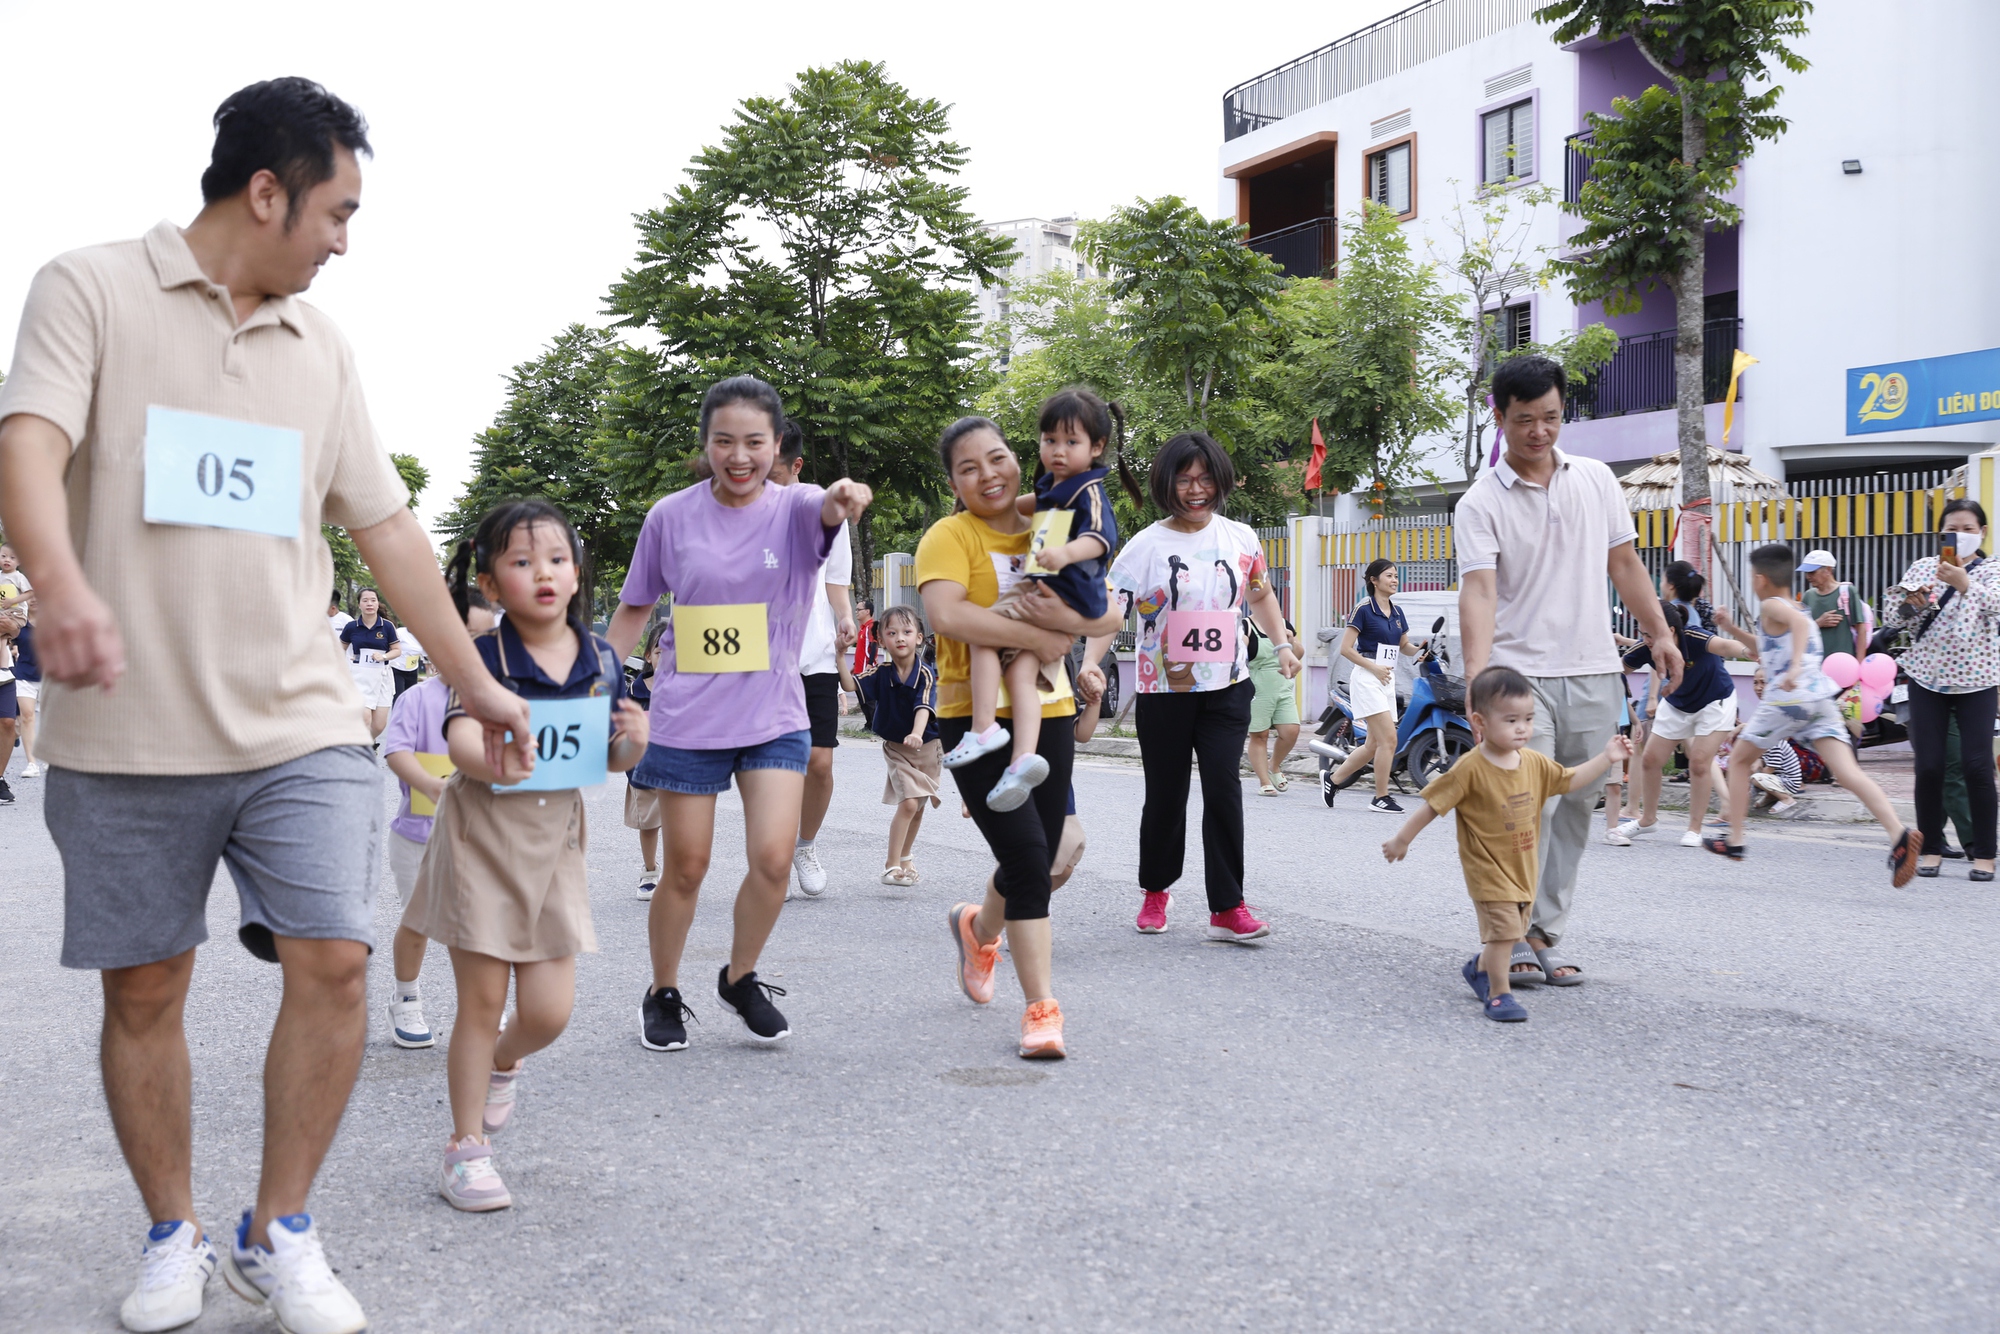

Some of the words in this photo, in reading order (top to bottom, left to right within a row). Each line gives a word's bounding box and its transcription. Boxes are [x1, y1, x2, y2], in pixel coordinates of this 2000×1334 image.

[1938, 391, 1976, 416] LIÊN
[197, 452, 255, 501] 05
[763, 549, 779, 569] LA
[703, 627, 741, 656] 88
[1181, 628, 1223, 652] 48
[537, 724, 582, 762] 05
